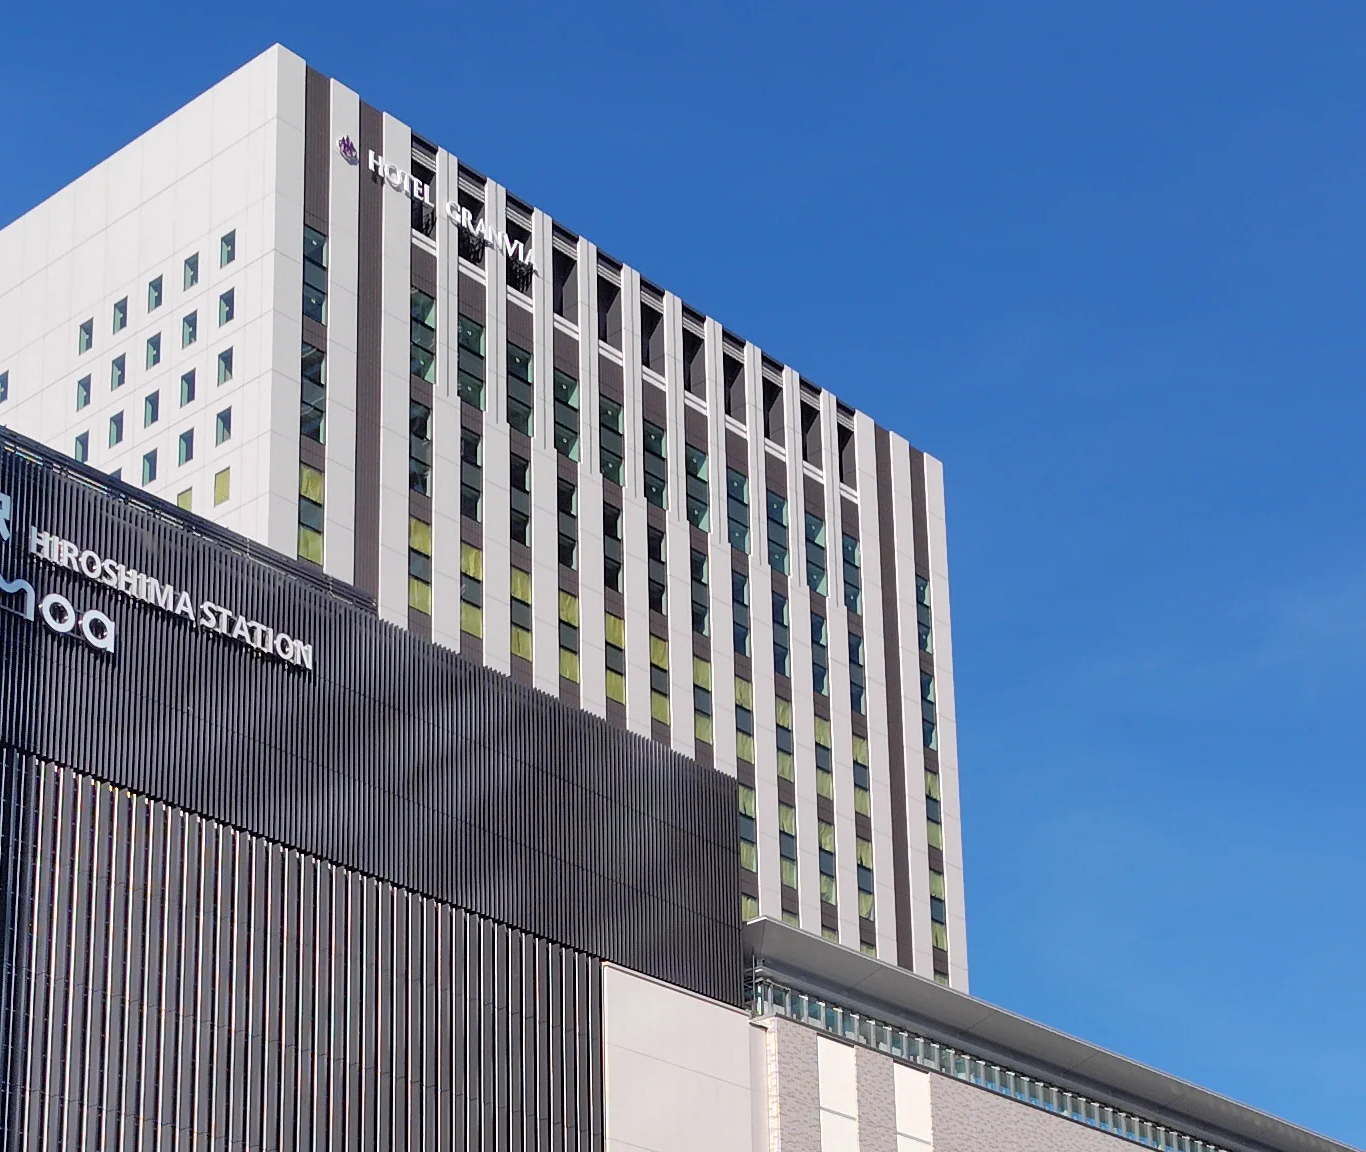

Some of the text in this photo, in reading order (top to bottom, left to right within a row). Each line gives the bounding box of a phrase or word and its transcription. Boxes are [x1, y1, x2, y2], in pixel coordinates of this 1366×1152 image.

[368, 149, 540, 276] HOTEL GRANVIA
[30, 526, 314, 670] HIROSHIMA STATION
